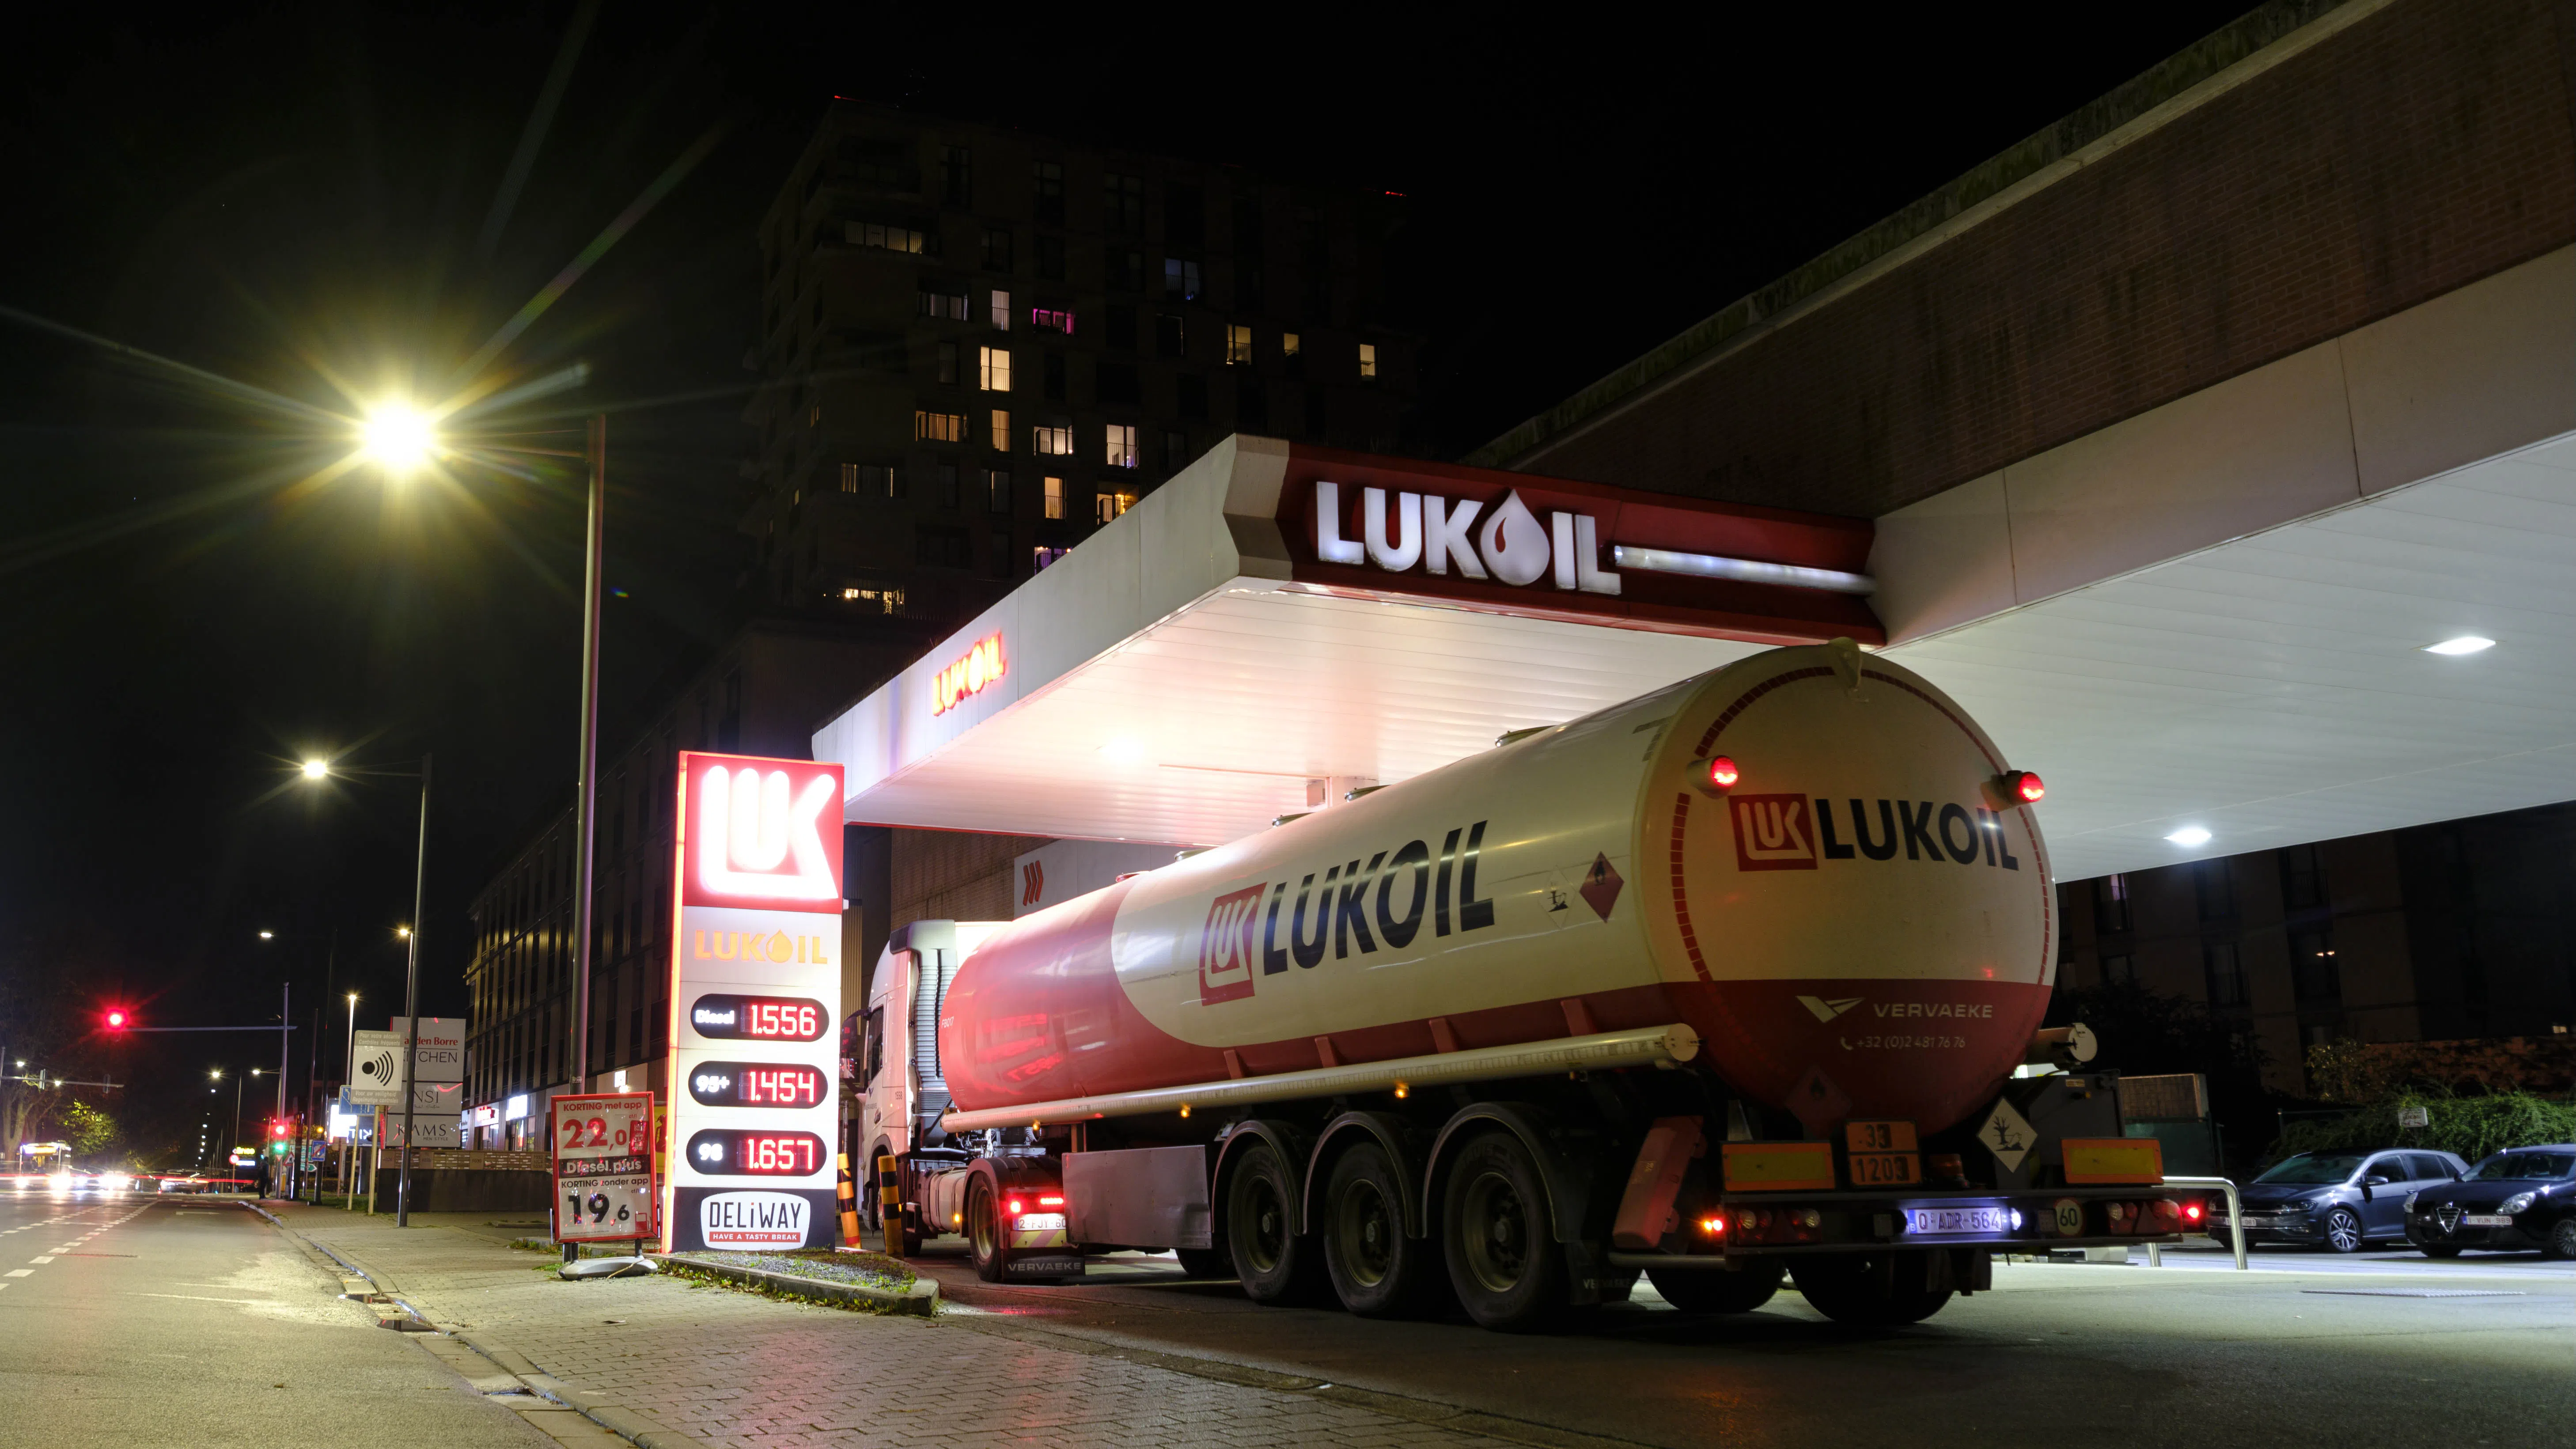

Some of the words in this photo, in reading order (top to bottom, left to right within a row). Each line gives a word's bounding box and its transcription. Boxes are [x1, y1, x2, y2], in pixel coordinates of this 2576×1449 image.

[1317, 482, 1621, 595] LUKOIL
[933, 632, 1006, 716] LUKOIL
[699, 765, 838, 899] LUK
[1815, 799, 2019, 871] LUKOIL
[1263, 820, 1494, 975] LUKOIL
[695, 929, 827, 964] LUKOIL
[752, 1005, 816, 1036] 1.556
[1873, 1004, 1993, 1018] VERVAEKE
[434, 1037, 458, 1046] Borre
[1938, 1036, 1950, 1048] 76
[1954, 1036, 1966, 1048] 76
[697, 1075, 730, 1092] 95+
[750, 1071, 814, 1102] 1.454
[563, 1103, 602, 1111] KORTING
[624, 1102, 642, 1110] app
[398, 1123, 446, 1136] KAMS
[563, 1117, 627, 1151] 22,0
[567, 1160, 609, 1174] Diesel
[614, 1159, 642, 1174] plus
[748, 1138, 813, 1169] 1.657
[1857, 1156, 1909, 1182] 1203
[561, 1180, 598, 1188] KORTING
[2060, 1207, 2078, 1226] 60
[1008, 1262, 1081, 1271] VERVAEKE
